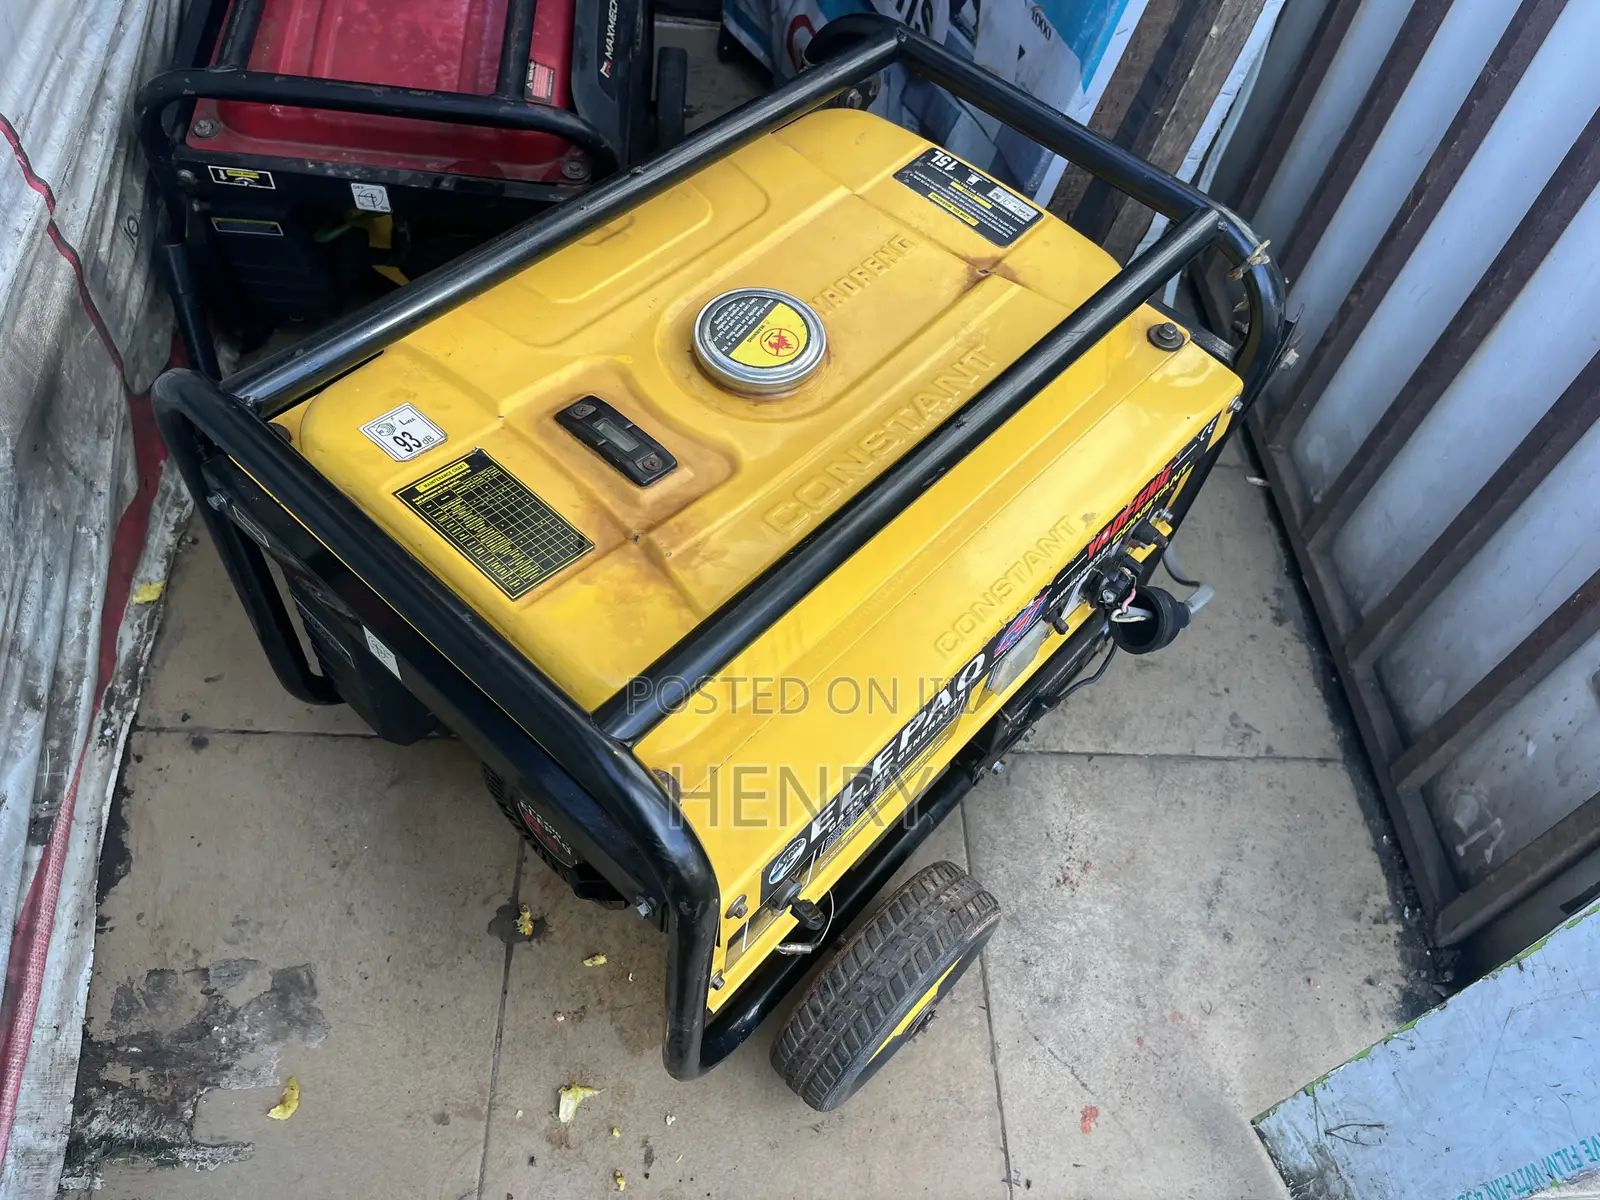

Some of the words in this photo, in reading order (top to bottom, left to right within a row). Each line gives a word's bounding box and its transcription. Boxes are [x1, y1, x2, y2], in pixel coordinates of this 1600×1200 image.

[930, 151, 959, 171] 15L
[746, 323, 764, 343] WARNING
[393, 431, 422, 453] 93
[422, 435, 434, 445] dB
[761, 346, 996, 537] CONSTANT
[452, 463, 467, 473] CHART
[1112, 461, 1190, 545] CONSTANT
[934, 515, 1075, 656] CONSTANT
[810, 653, 985, 844] ELEPAQ
[828, 766, 890, 832] GASOLINE
[897, 690, 965, 762] GENERATOR
[1541, 1145, 1584, 1179] FILM
[1485, 1162, 1546, 1200] WITHIN
